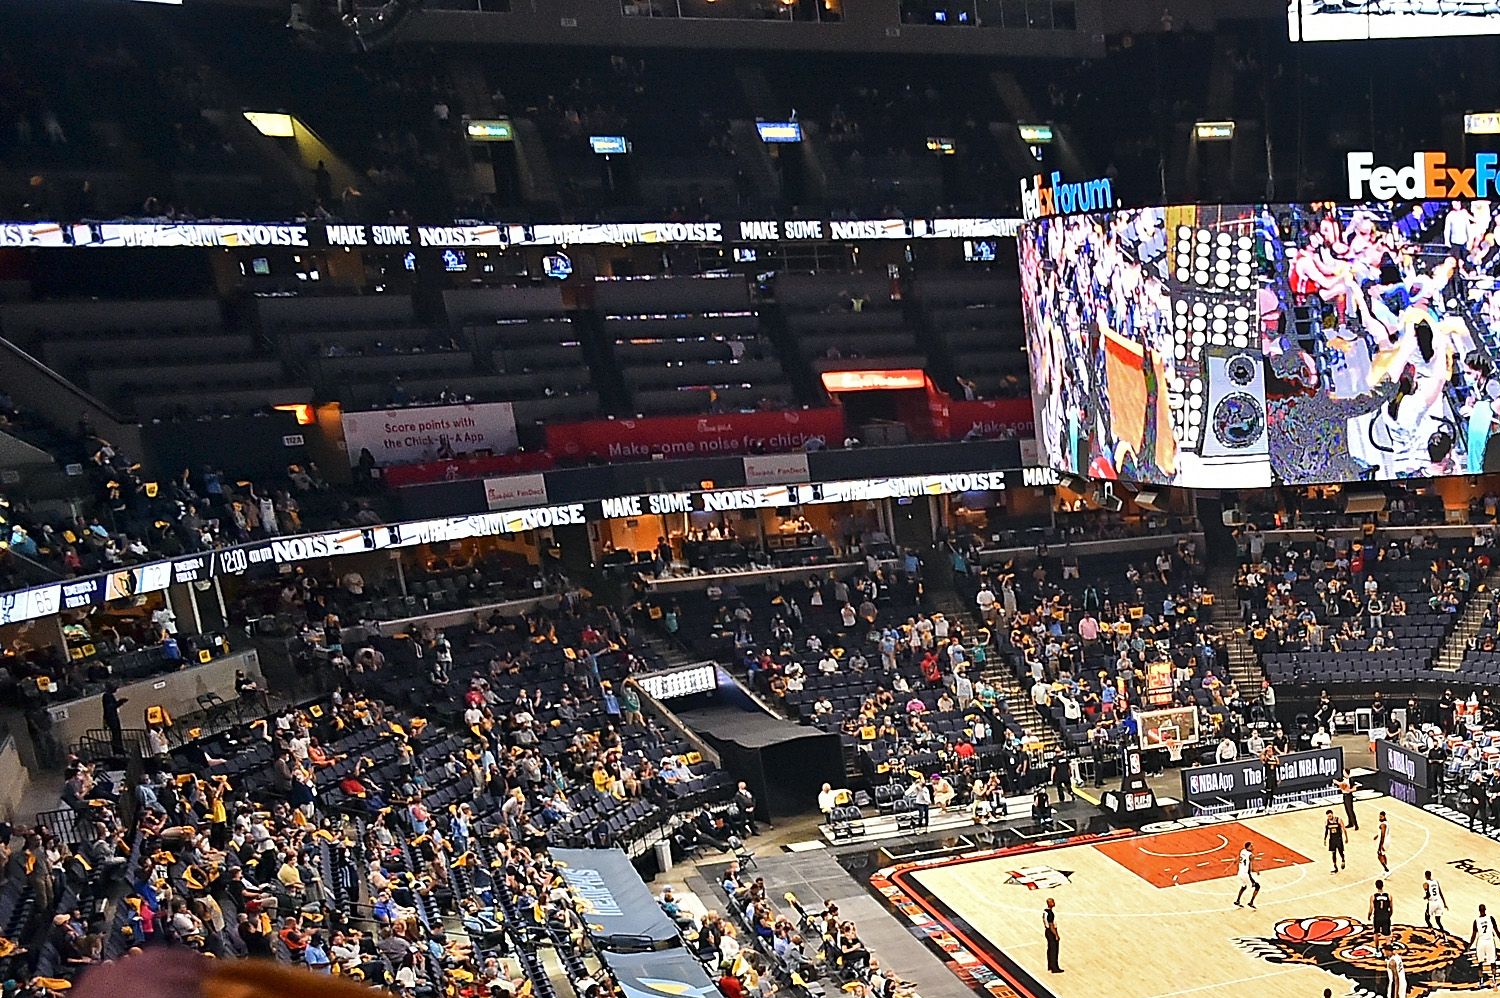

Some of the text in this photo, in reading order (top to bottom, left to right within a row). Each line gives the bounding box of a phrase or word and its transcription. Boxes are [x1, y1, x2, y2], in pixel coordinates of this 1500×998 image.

[1020, 171, 1112, 219] FedExForum
[238, 224, 308, 246] NOISE
[326, 225, 479, 246] MAKE SOME NOISE
[657, 223, 722, 243] NOISE
[740, 220, 889, 240] MAKE SOME NOISE
[384, 417, 475, 434] Score points with
[972, 421, 1035, 433] Make som
[384, 432, 484, 449] the Chick-fil-A App
[608, 442, 649, 457] Make
[652, 441, 694, 455] ome
[700, 437, 740, 451] noise
[942, 471, 1005, 493] NOISE
[1023, 468, 1060, 487] MAKE
[602, 489, 768, 518] MAKE SOME NOISE
[521, 504, 586, 528] NOISE
[273, 535, 343, 563] NOISE
[221, 548, 248, 574] 12:00
[1243, 766, 1262, 786] The
[1298, 758, 1317, 777] NBA
[1319, 756, 1338, 775] App
[1199, 772, 1234, 793] NBA App
[1482, 924, 1488, 934] 7
